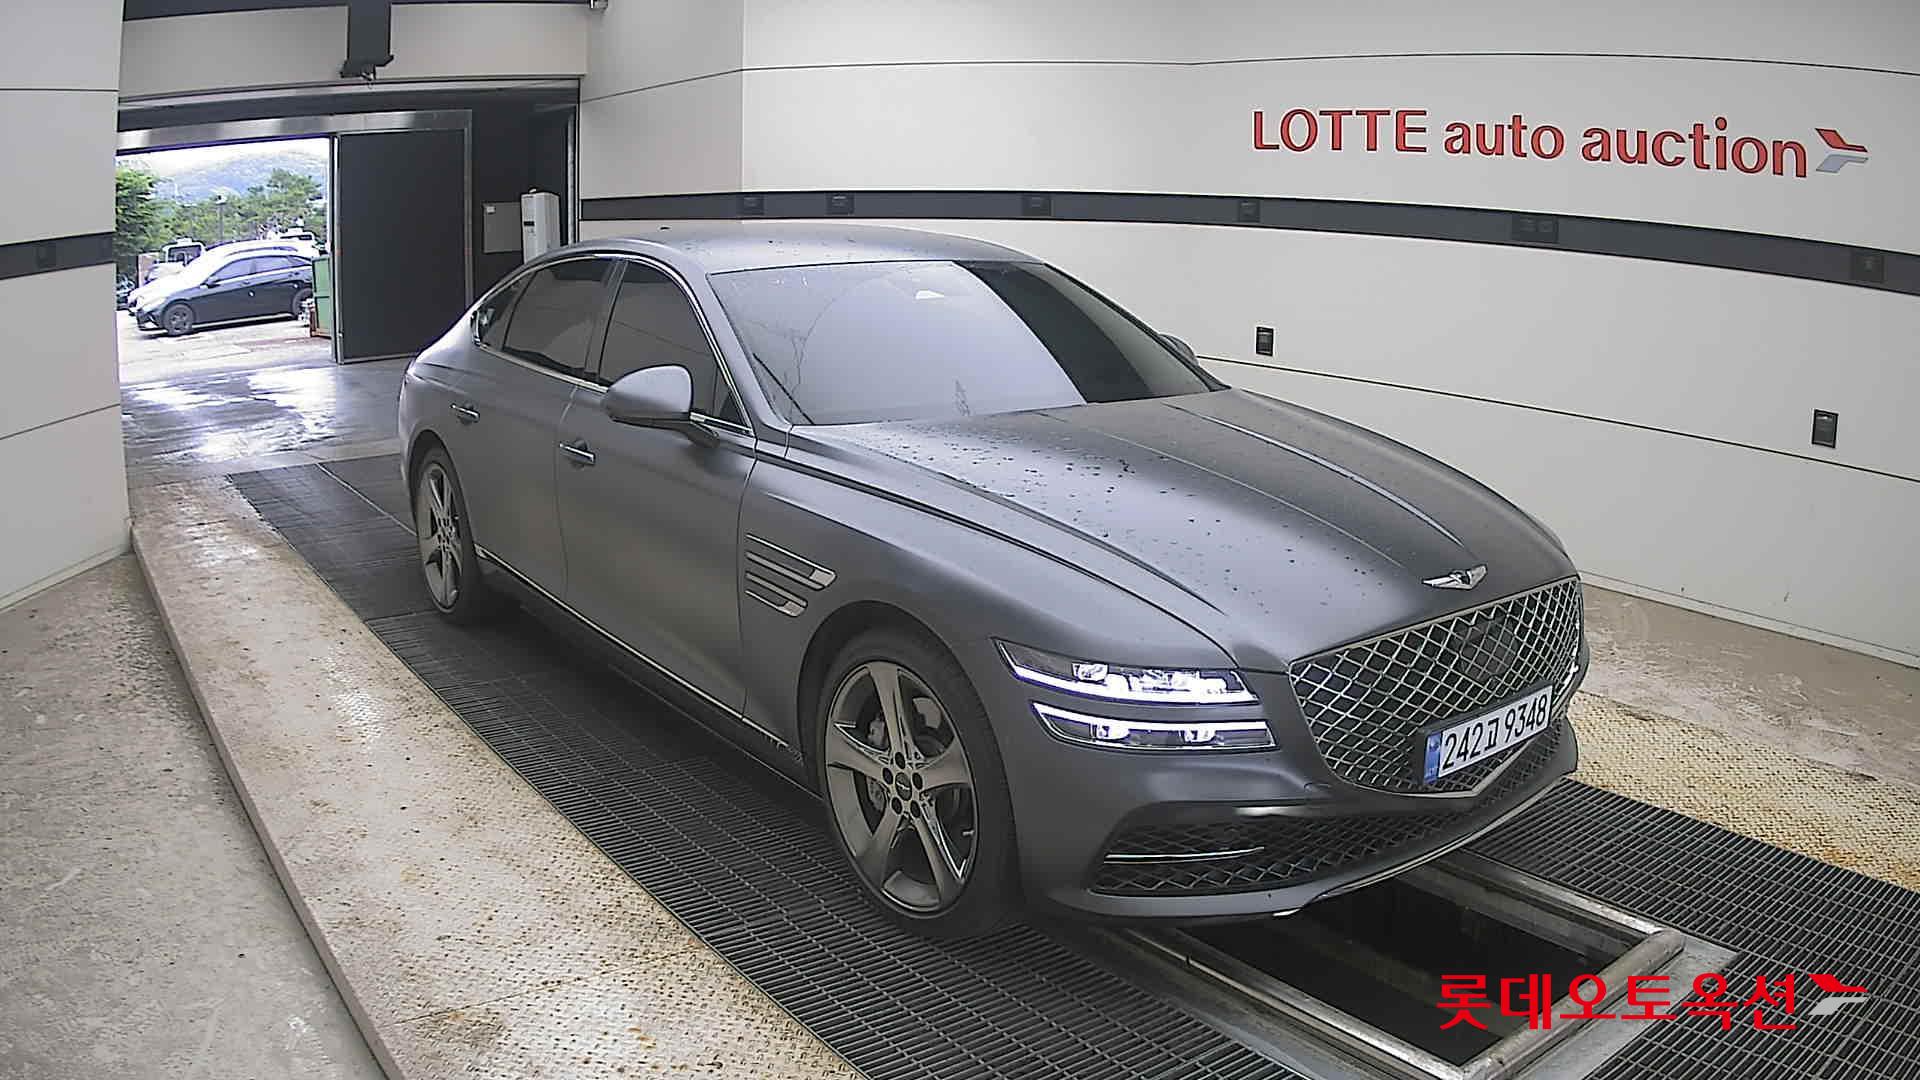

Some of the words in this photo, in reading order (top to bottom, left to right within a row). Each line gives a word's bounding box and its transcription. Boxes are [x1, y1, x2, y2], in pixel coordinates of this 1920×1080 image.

[1252, 108, 1428, 152] LOTTE
[1443, 114, 1566, 159] auto
[1581, 116, 1808, 178] auction
[1442, 717, 1500, 770] 242고
[1504, 694, 1548, 743] 9348
